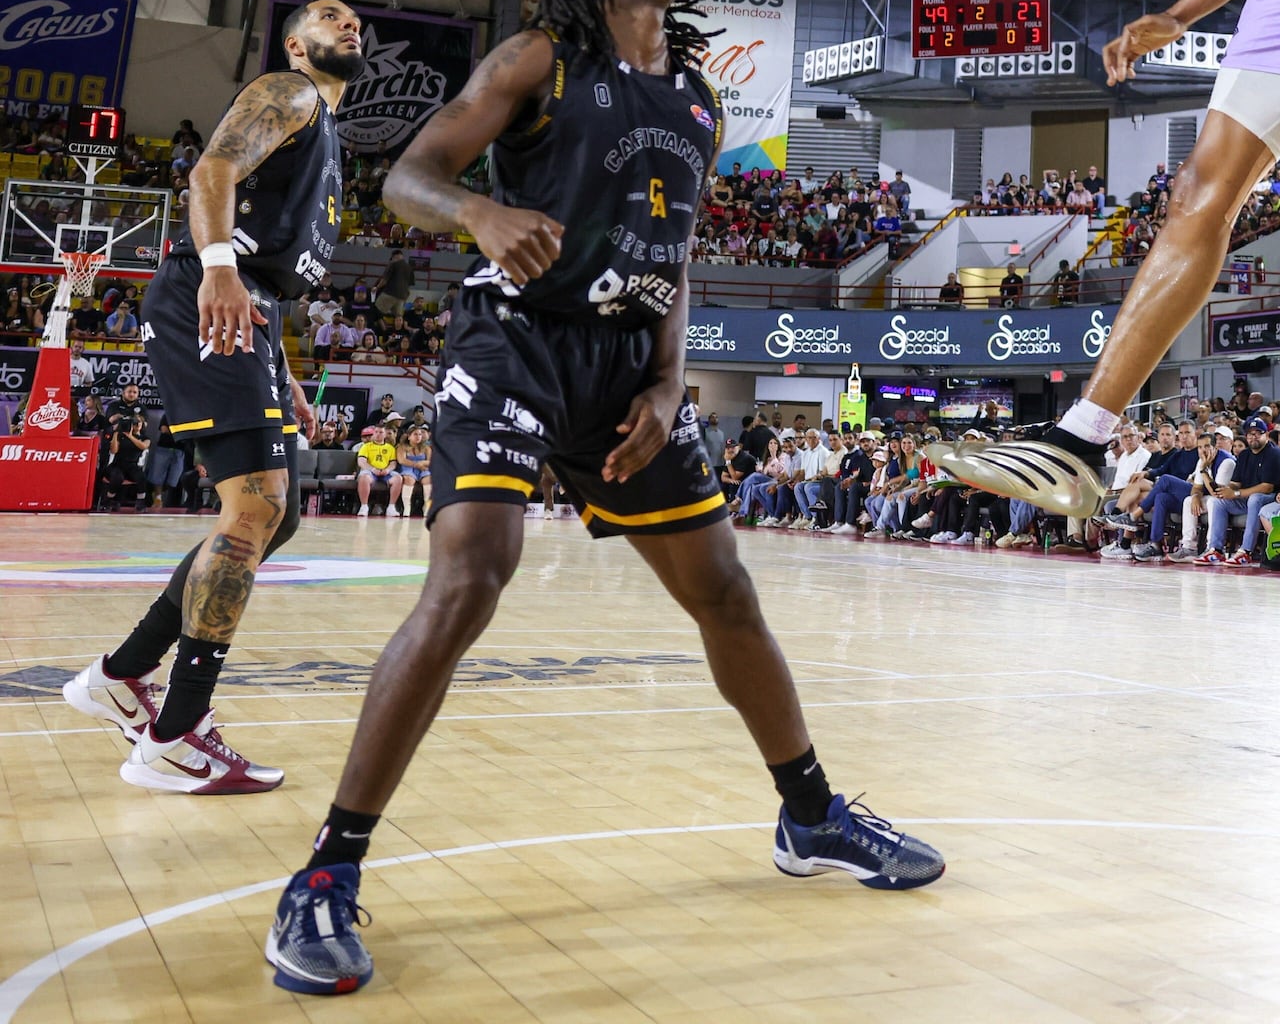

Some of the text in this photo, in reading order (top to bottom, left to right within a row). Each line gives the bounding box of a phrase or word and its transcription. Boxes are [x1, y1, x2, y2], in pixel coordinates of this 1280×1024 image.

[723, 6, 781, 20] Mendoza
[926, 7, 948, 23] 49
[976, 7, 984, 20] 2
[1017, 2, 1040, 20] 27
[930, 35, 933, 46] 1
[945, 33, 953, 46] 2
[1007, 30, 1015, 44] 0
[1032, 29, 1039, 42] 3
[343, 63, 443, 107] urch's
[718, 87, 740, 100] de
[346, 104, 417, 119] CHICKEN
[343, 127, 371, 140] SINCE
[68, 143, 118, 156] CITIZEN
[639, 292, 669, 316] UNION
[686, 322, 723, 338] ecial
[1244, 323, 1268, 332] CHARLIE
[686, 338, 736, 352] casions
[910, 387, 936, 397] ULTRA
[25, 449, 87, 463] TRIPLE-S
